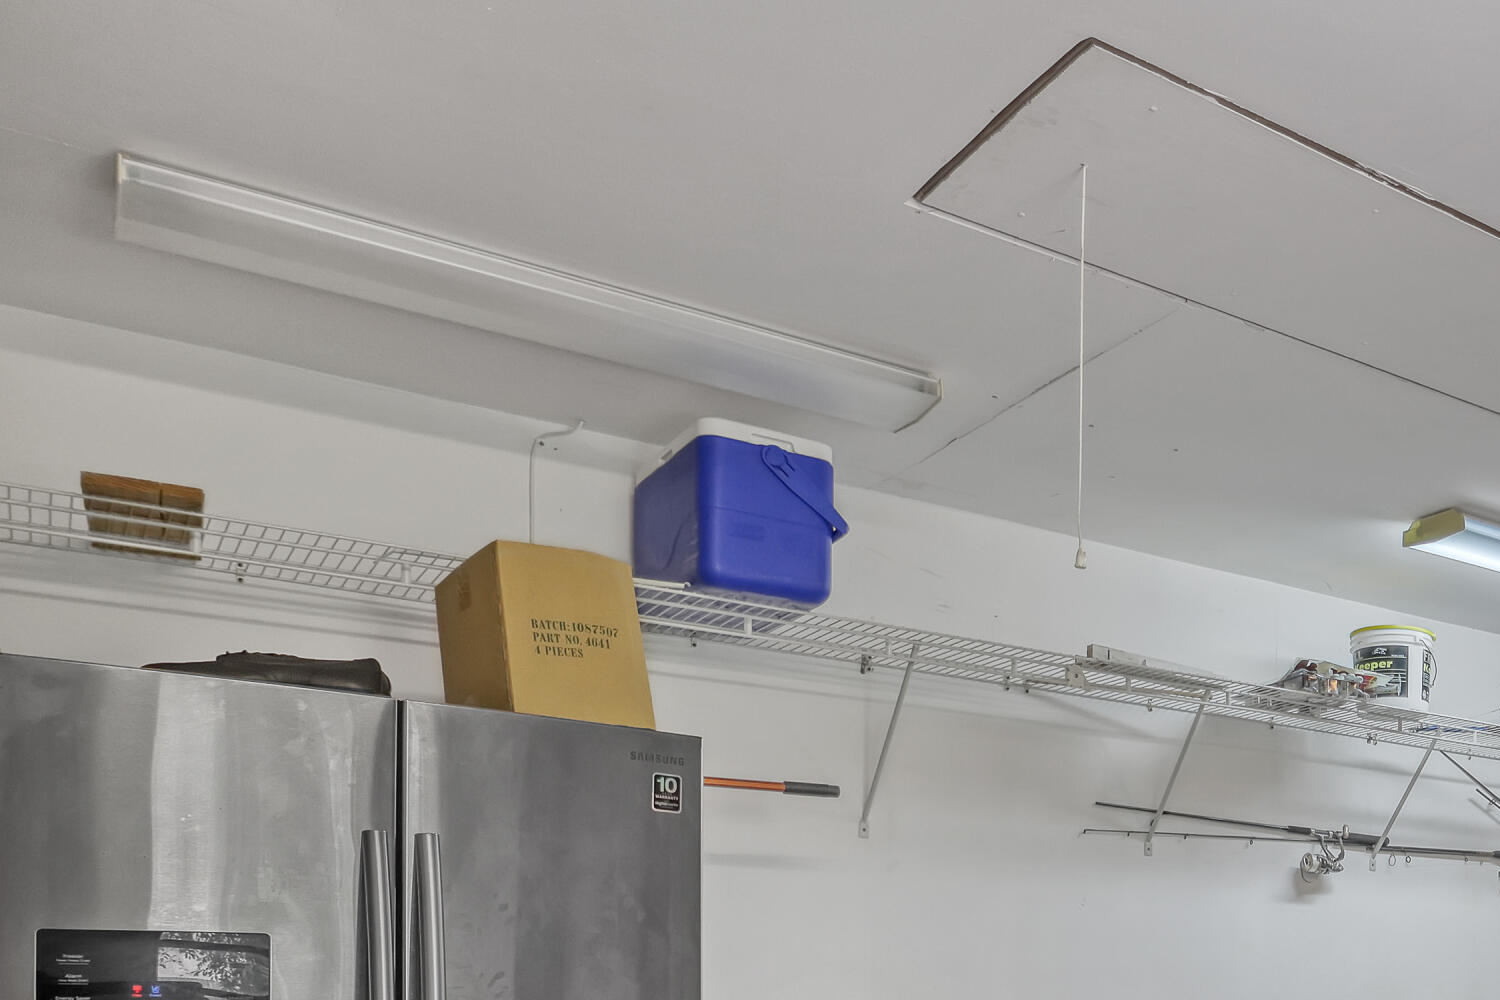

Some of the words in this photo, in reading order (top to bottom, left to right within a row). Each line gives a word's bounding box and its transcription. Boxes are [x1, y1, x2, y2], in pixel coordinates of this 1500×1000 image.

[532, 631, 561, 643] PART
[565, 634, 583, 646] NO.
[585, 637, 611, 649] 4641
[535, 645, 541, 655] 4
[545, 645, 584, 658] PIECES
[630, 751, 685, 766] SAMSUNG
[656, 776, 678, 793] 10
